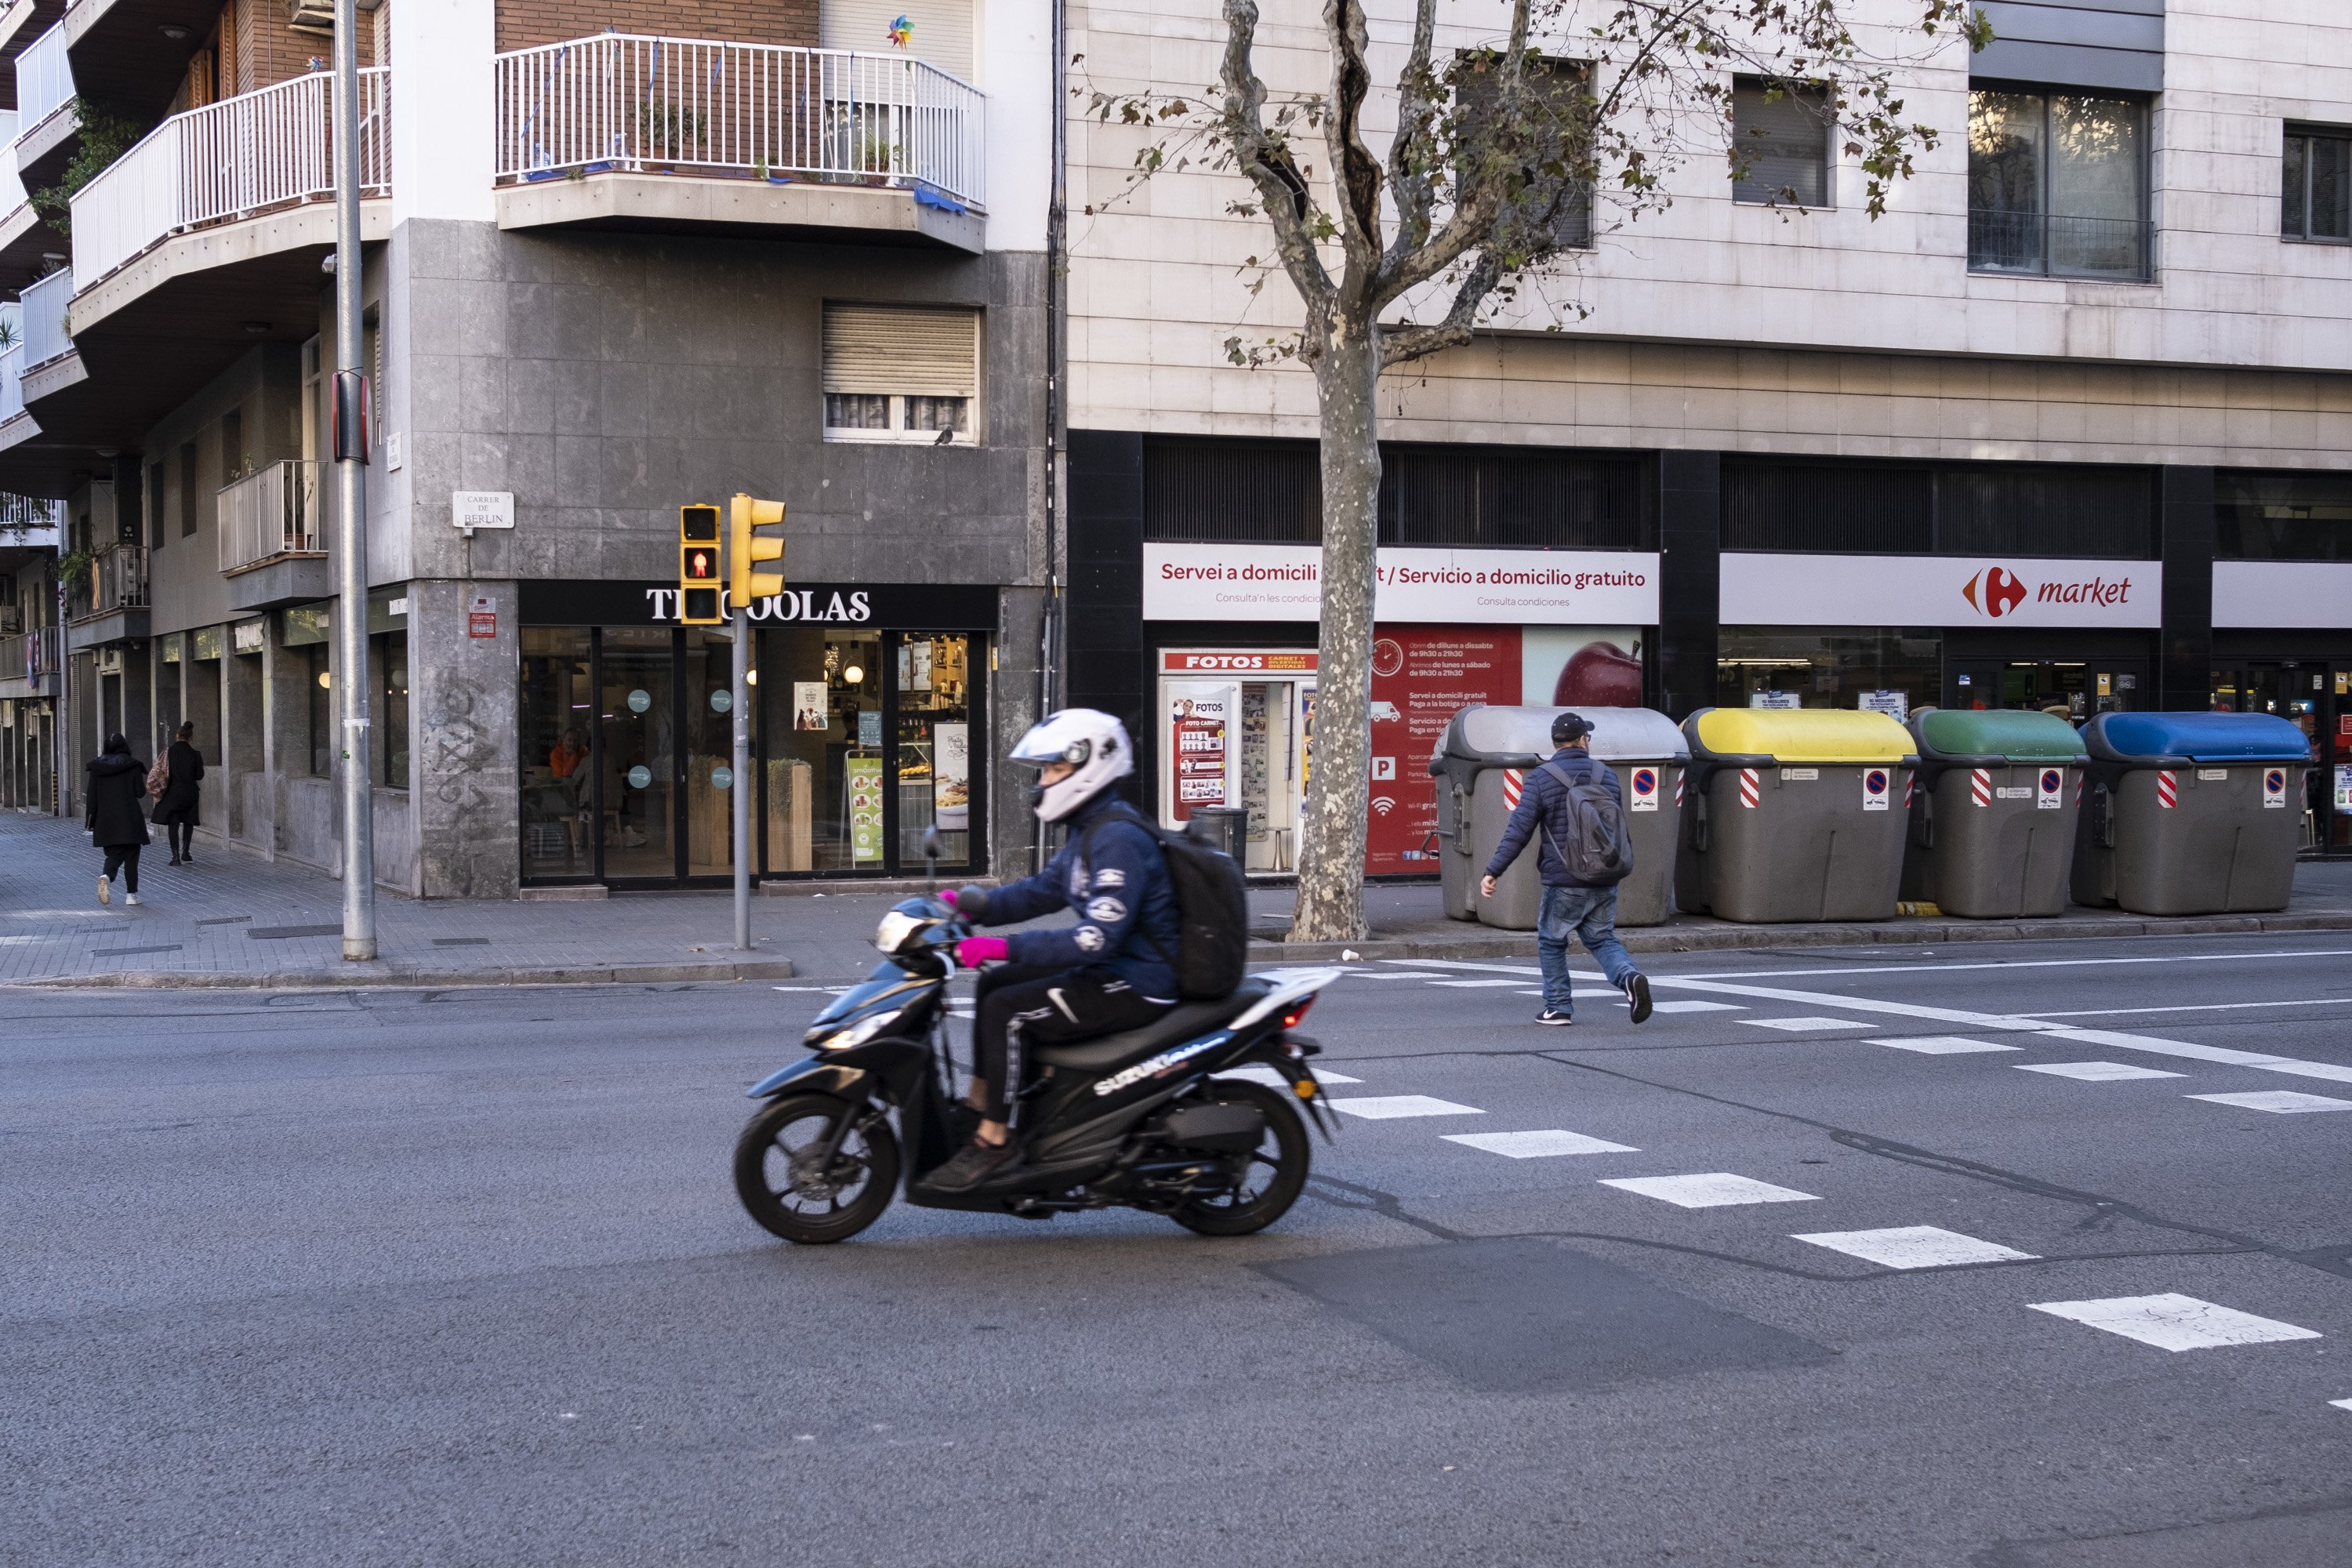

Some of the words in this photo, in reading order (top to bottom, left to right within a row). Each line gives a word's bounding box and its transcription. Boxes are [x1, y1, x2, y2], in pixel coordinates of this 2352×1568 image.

[465, 514, 503, 524] BERLIN
[1161, 563, 1222, 580] Servei
[1227, 570, 1237, 580] a
[1242, 564, 1316, 581] domicili
[1399, 567, 1472, 584] Servicio
[1476, 572, 1486, 584] a
[1490, 568, 1572, 586] domicilio
[1574, 570, 1646, 590] gratuito
[2038, 576, 2132, 608] market
[1215, 593, 1265, 603] Consulta'n
[1267, 593, 1280, 603] les
[1477, 596, 1516, 606] Consulta
[1517, 597, 1570, 607] condiciones
[1186, 655, 1262, 669] FOTOS
[1196, 703, 1223, 712] FOTOS
[1439, 700, 1460, 709] botiga
[1093, 1054, 1173, 1096] SUZUKI
